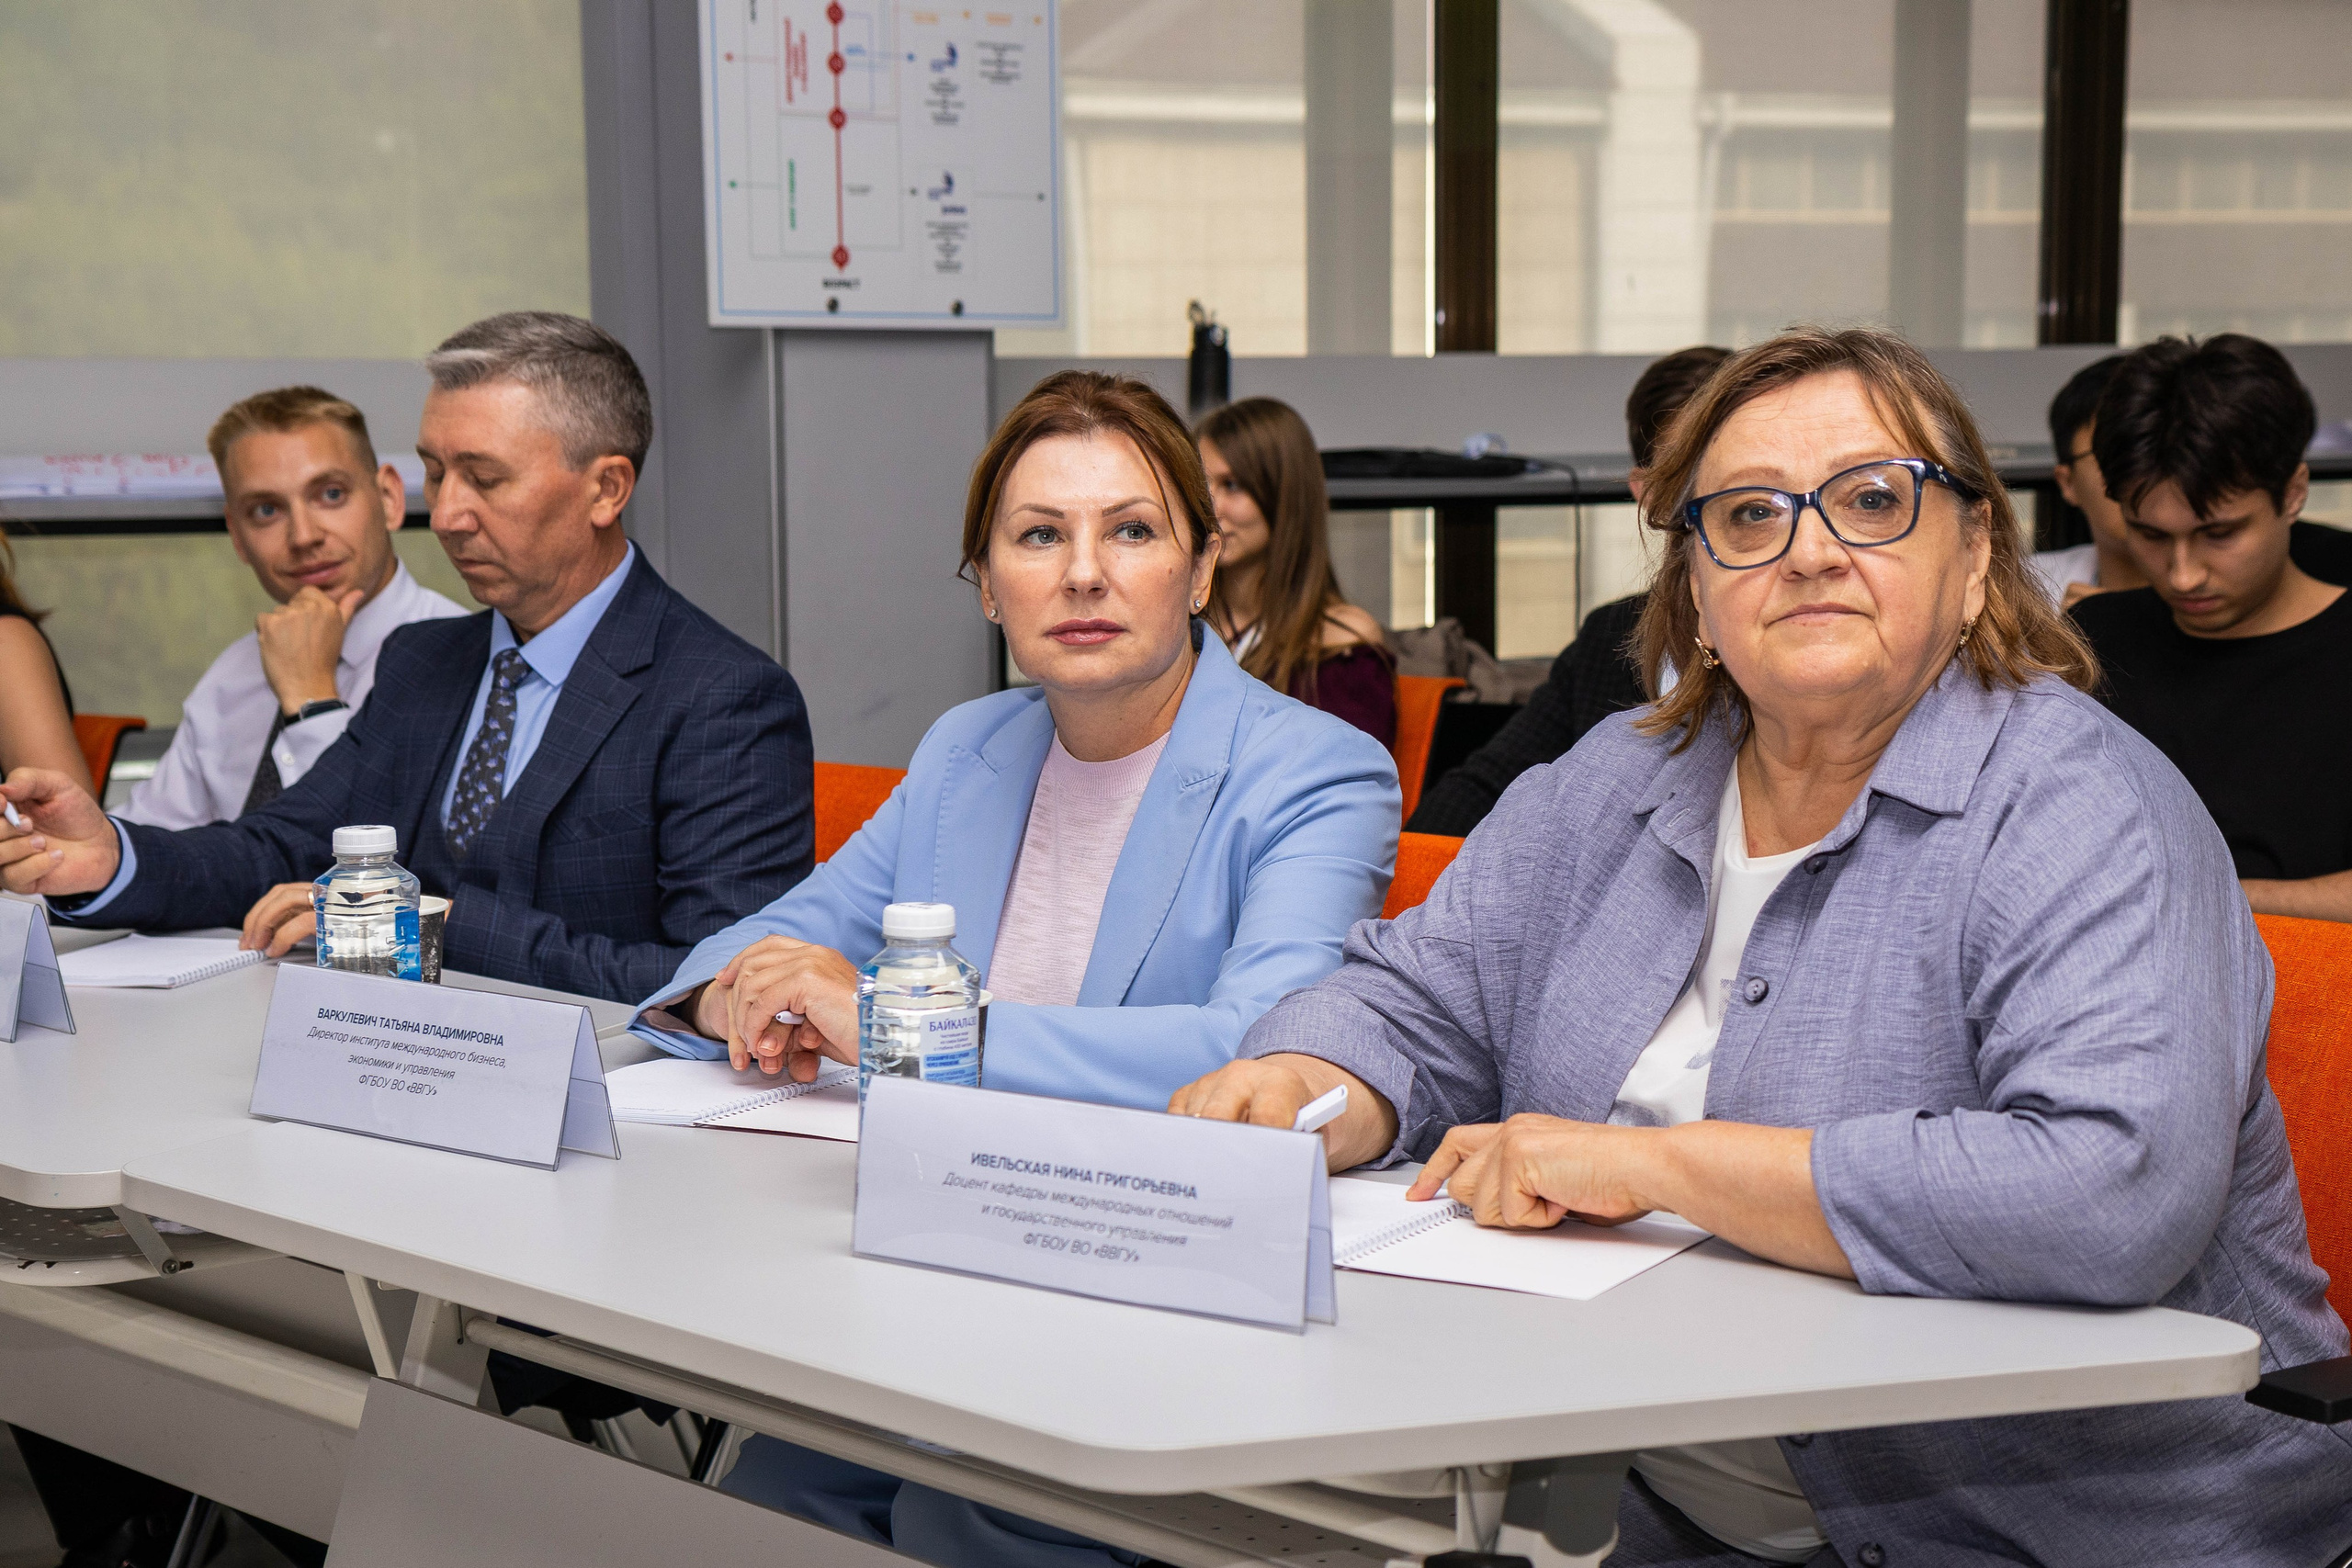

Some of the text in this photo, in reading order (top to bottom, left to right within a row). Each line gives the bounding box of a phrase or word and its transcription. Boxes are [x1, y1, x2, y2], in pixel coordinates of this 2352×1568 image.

[307, 1026, 506, 1068] Директор института международного бизнеса,
[317, 1008, 503, 1046] ВАРКУЛЕВИЧ ТАТЬЯНА ВЛАДИМИРОВНА
[348, 1055, 456, 1079] экономики и управления
[358, 1074, 437, 1095] ФГБОУ ВО «ВВГУ»
[971, 1152, 1198, 1200] ИВЕЛЬСКАЯ НИНА ГРИГОРЬЕВНА
[942, 1171, 1234, 1230] Доцент кафедры международных отношений
[981, 1204, 1188, 1247] и государственного управления
[1023, 1232, 1139, 1262] ФГБОУ ВО «ВВГУ»
